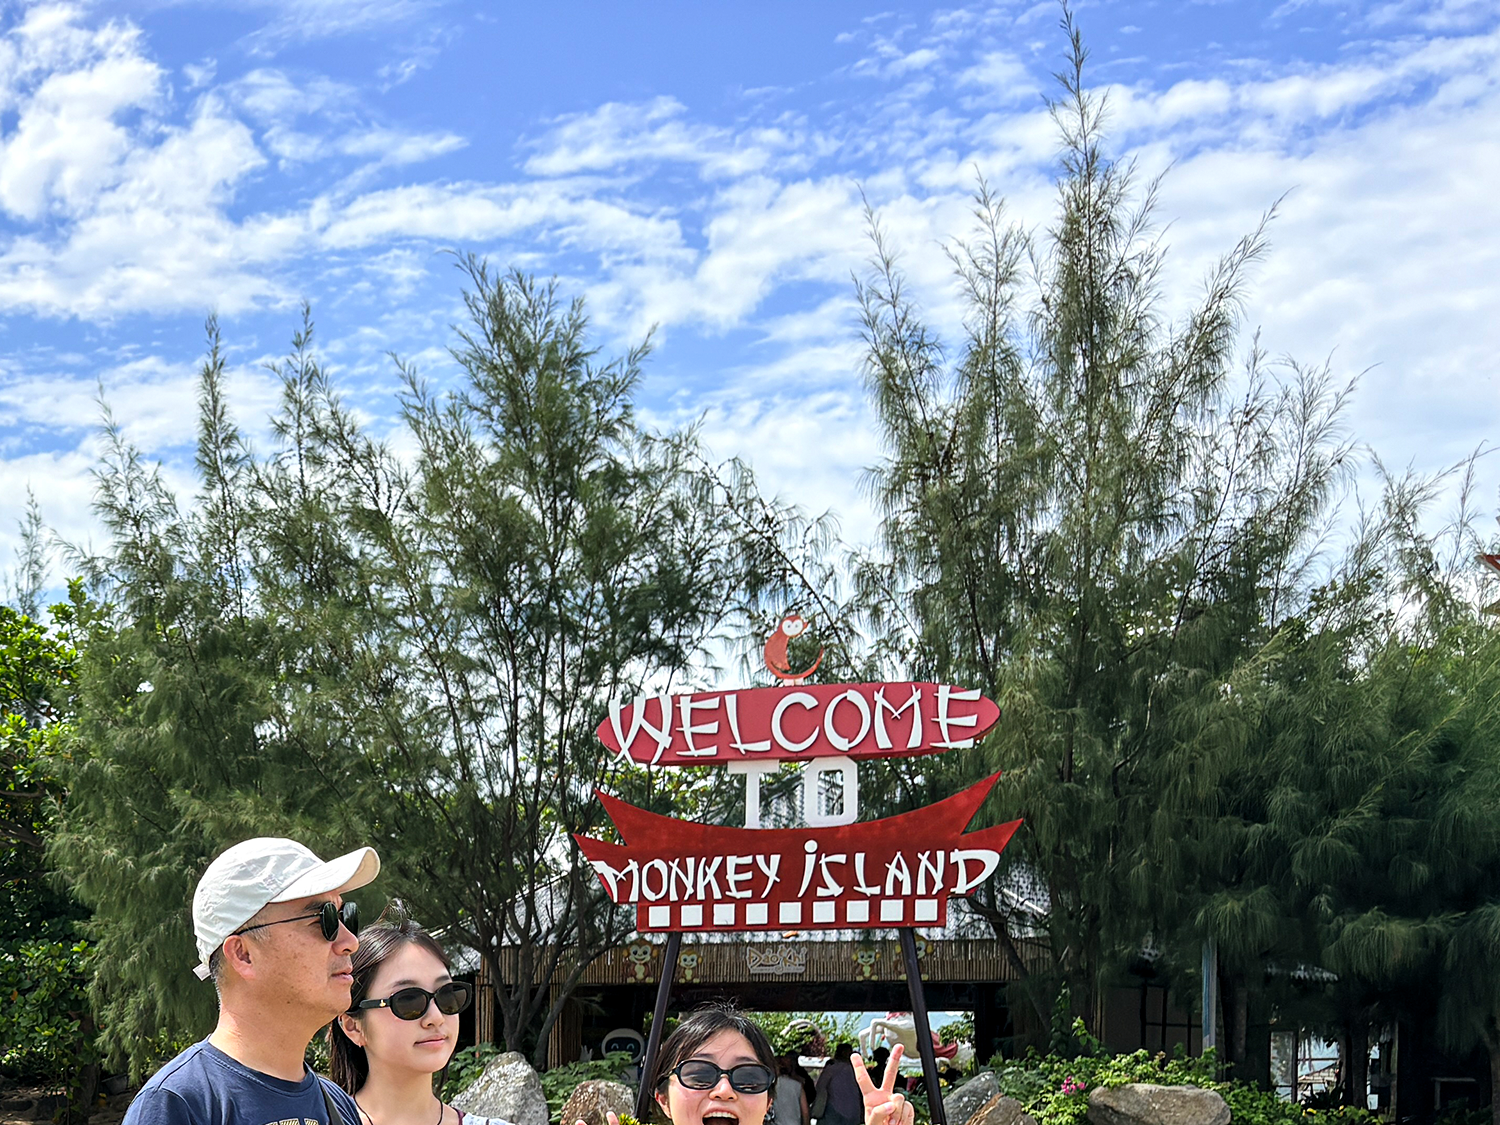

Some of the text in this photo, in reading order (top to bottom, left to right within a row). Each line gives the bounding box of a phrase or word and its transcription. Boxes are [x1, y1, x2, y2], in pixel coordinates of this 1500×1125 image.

[608, 683, 983, 766] WELCOME
[727, 756, 859, 829] TO
[589, 853, 781, 903] MONKEY
